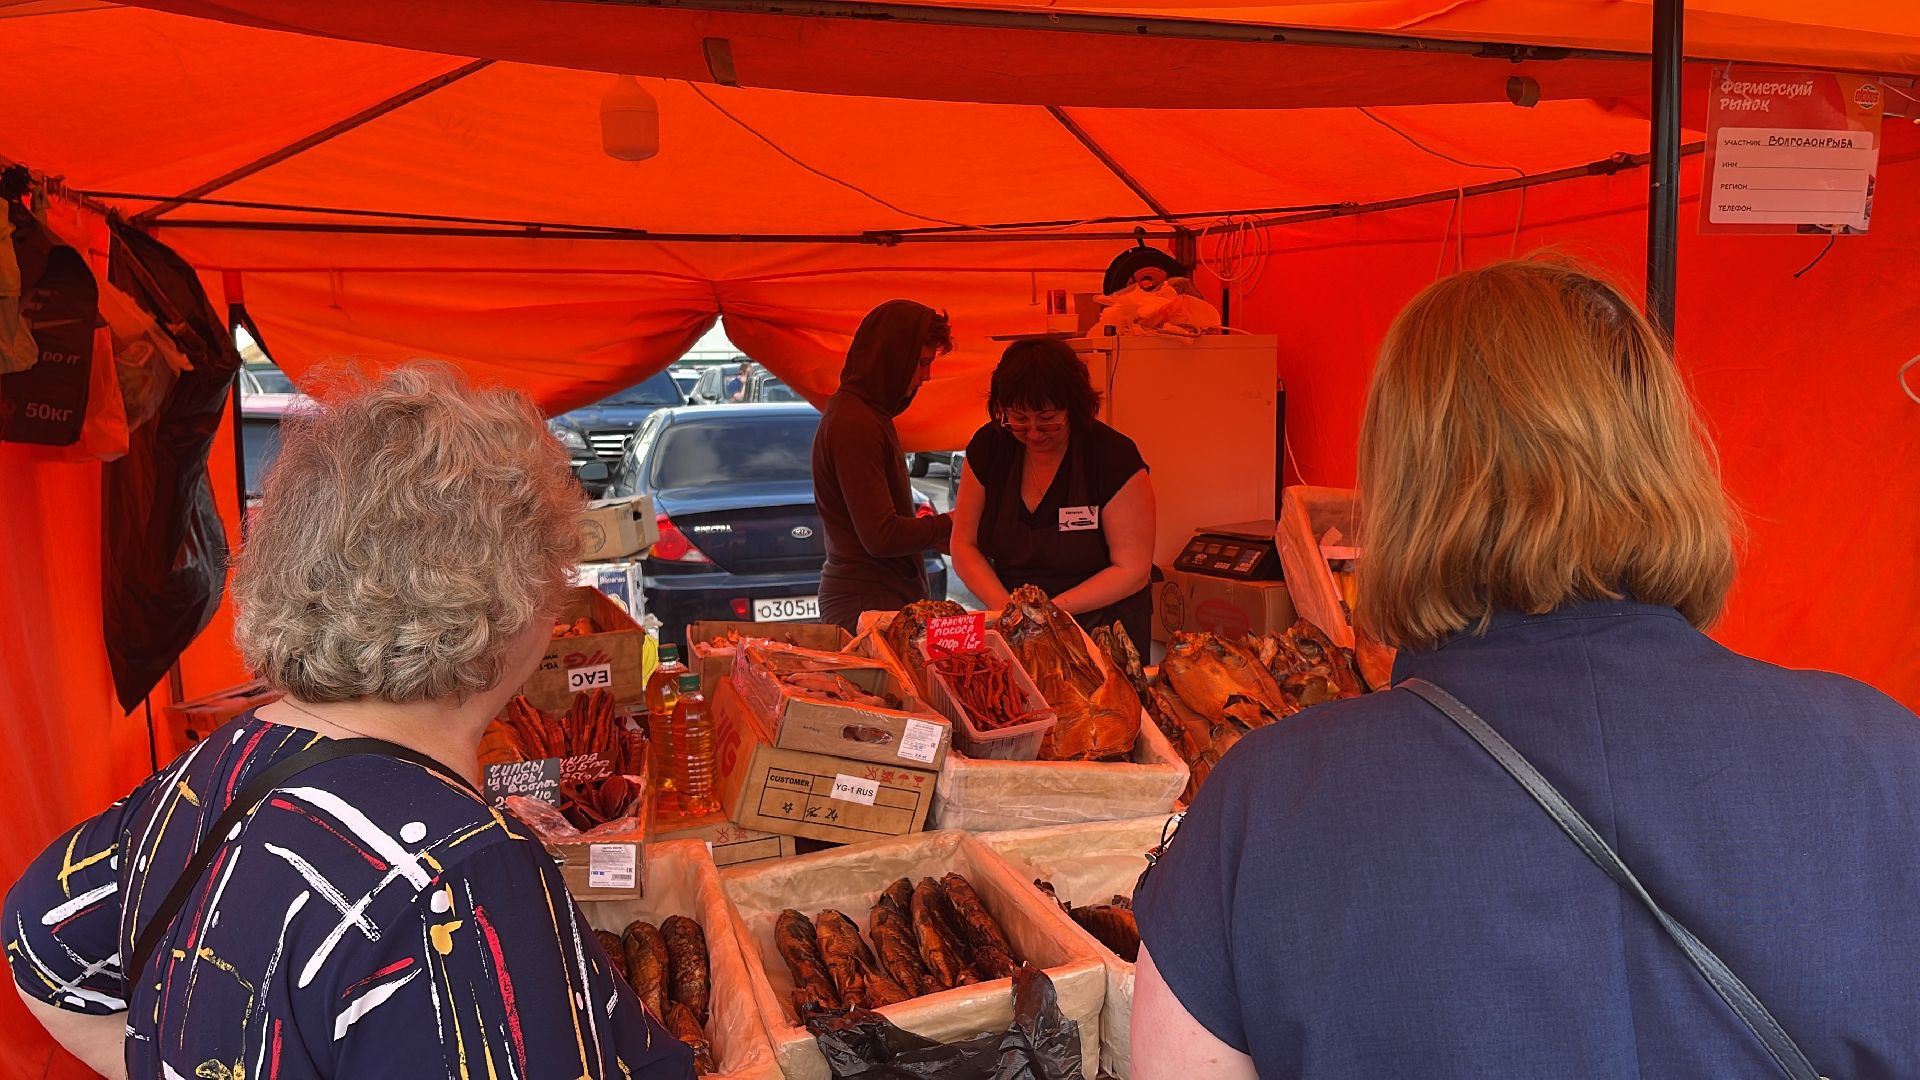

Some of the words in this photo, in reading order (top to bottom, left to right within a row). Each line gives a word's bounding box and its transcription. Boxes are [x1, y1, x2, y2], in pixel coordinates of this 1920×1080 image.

[1768, 136, 1853, 148] ВОЛГОДОНРЫБА
[42, 351, 63, 363] DO
[66, 354, 81, 365] IT
[769, 774, 810, 787] CUSTOMER
[836, 783, 855, 794] YG-1
[855, 787, 874, 797] RUS
